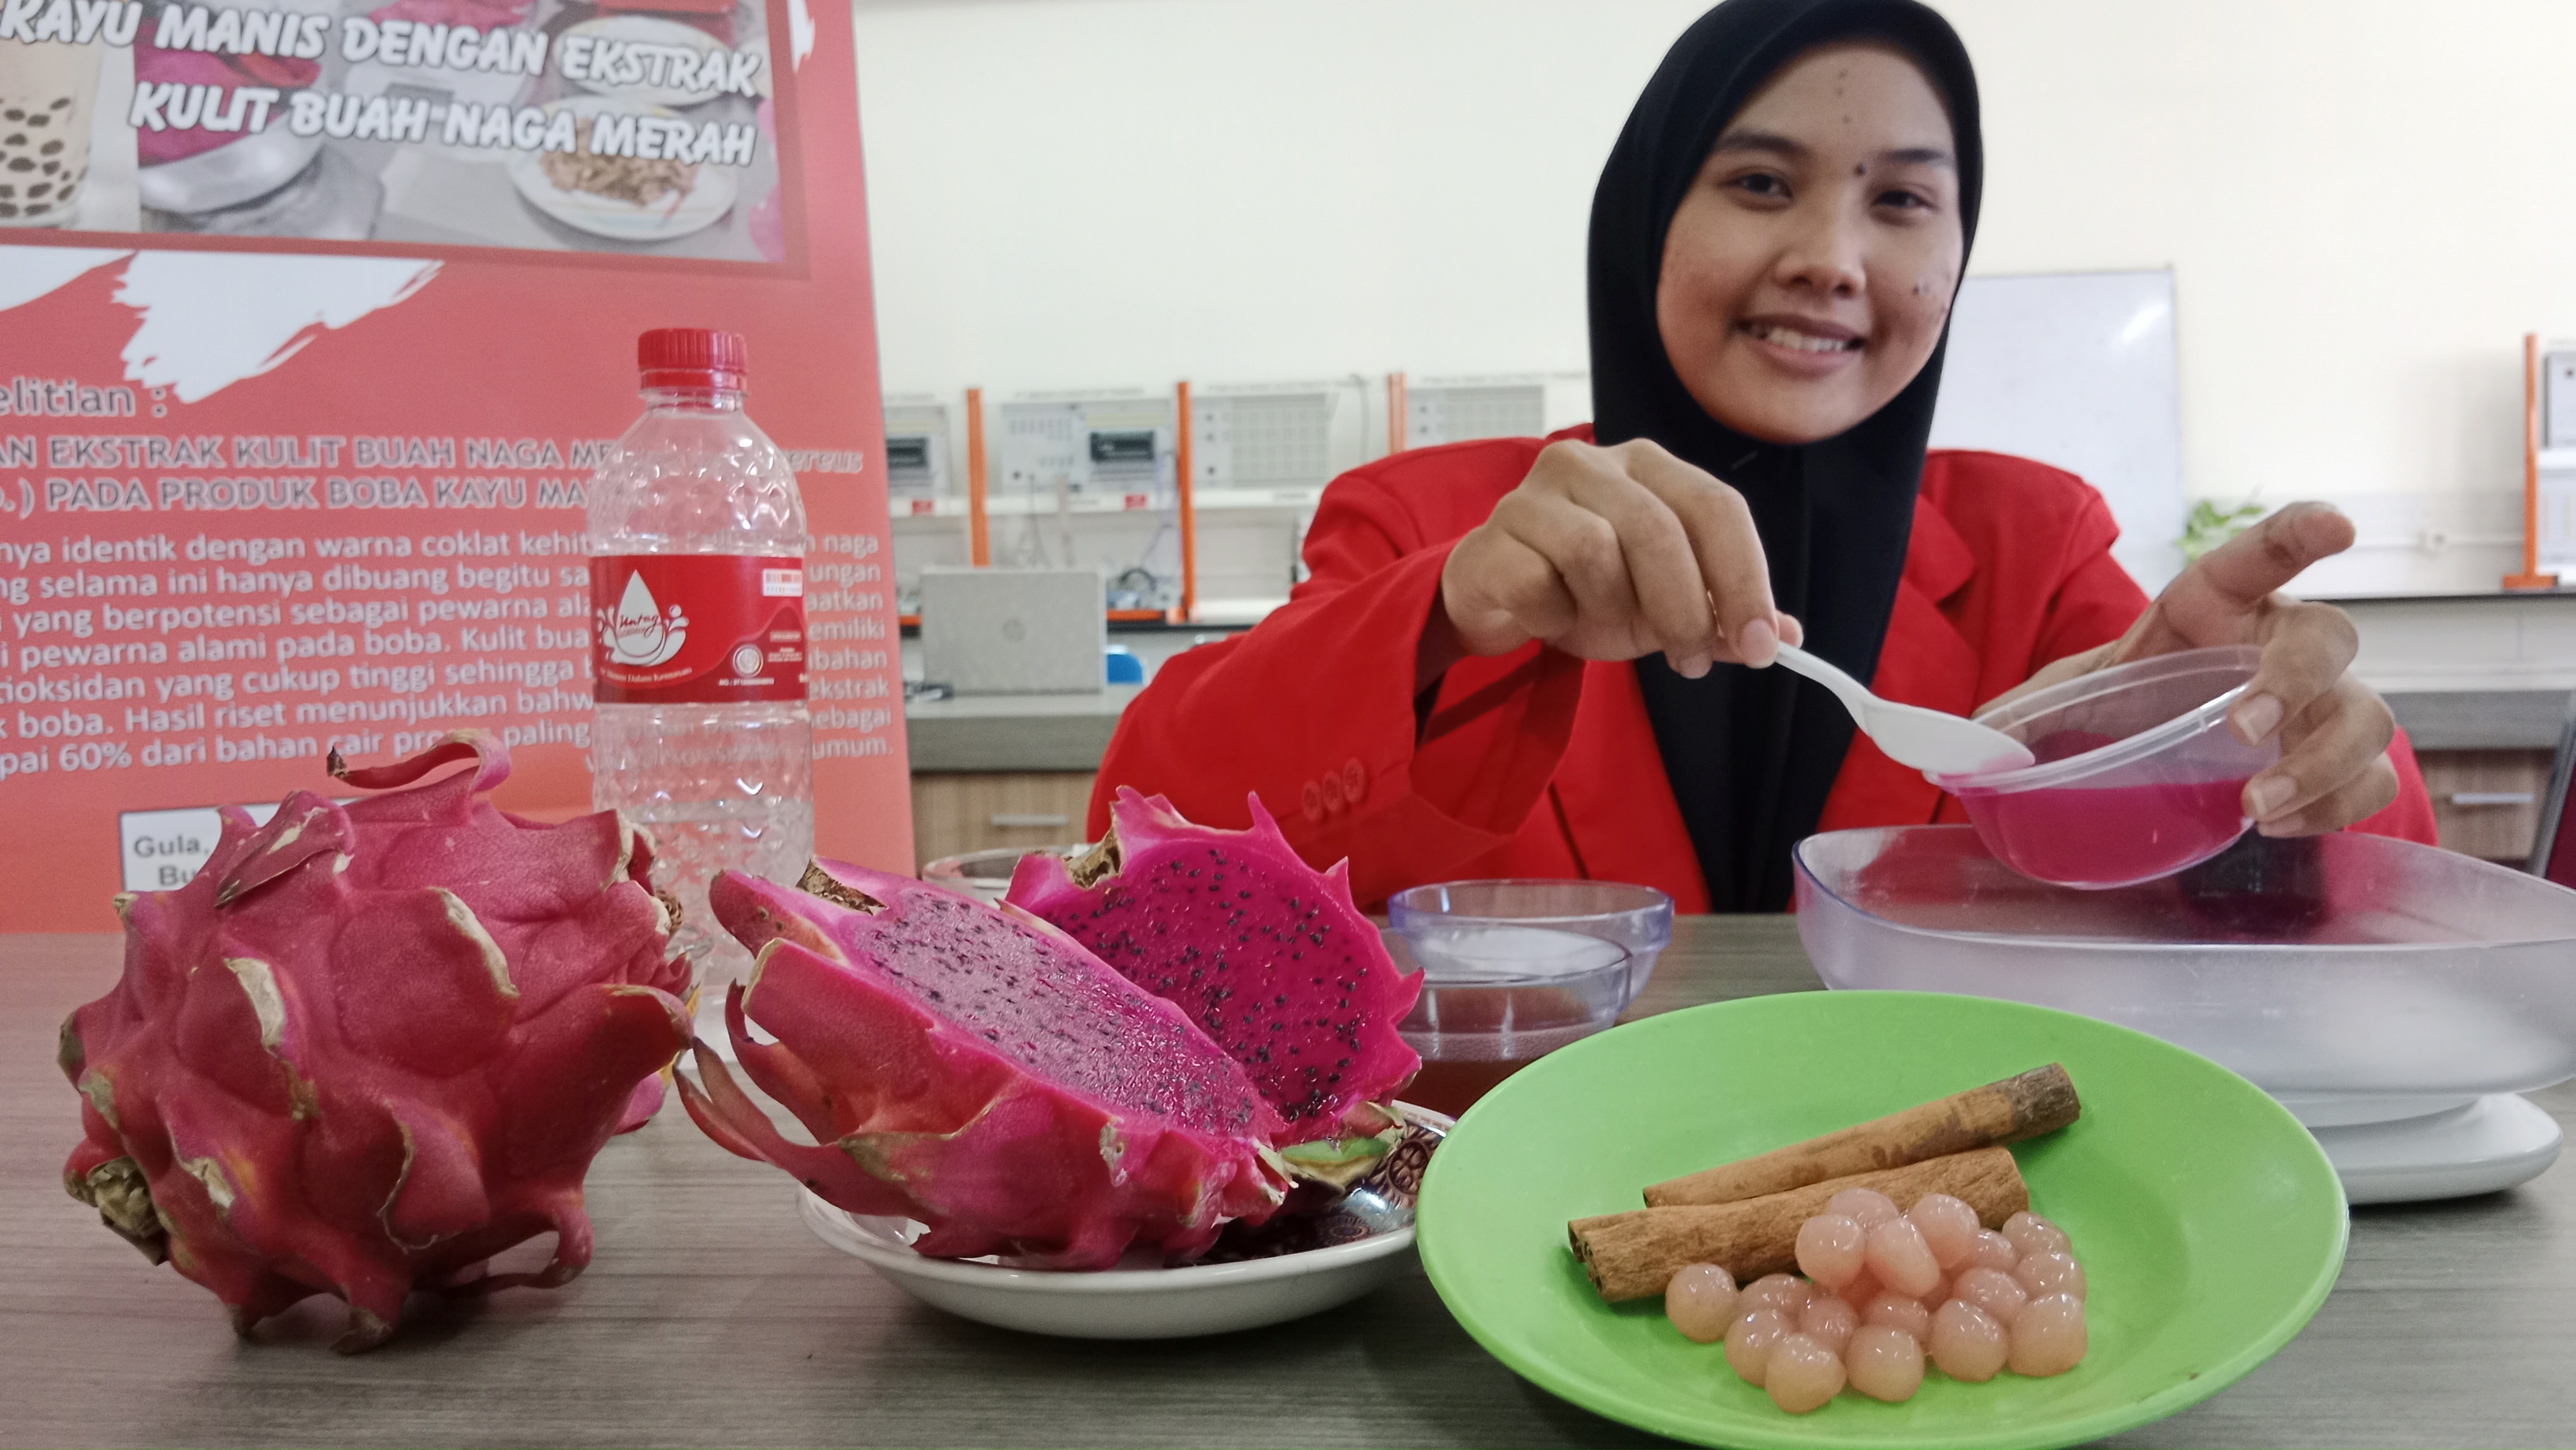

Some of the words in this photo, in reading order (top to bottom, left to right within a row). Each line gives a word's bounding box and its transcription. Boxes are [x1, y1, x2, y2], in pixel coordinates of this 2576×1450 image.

[0, 0, 143, 46] KAYU
[155, 4, 330, 58] MANIS
[342, 16, 549, 77] DENGAN
[562, 36, 764, 97] EKSTRAK
[128, 81, 280, 133] KULIT
[289, 92, 431, 143] BUAH
[442, 102, 576, 155] NAGA
[590, 113, 756, 166] MERAH
[47, 435, 226, 468] EKSTRAK
[233, 434, 346, 468] KULIT
[354, 436, 456, 469] BUAH
[465, 438, 564, 469] NAGA
[45, 476, 152, 511] PADA
[158, 477, 319, 511] PRODUK
[327, 476, 429, 509] BOBA
[433, 478, 527, 509] KAYU
[536, 477, 592, 509] MA
[62, 534, 177, 563] identik
[186, 534, 306, 565] dengan
[315, 536, 412, 558] warna
[421, 530, 510, 556] coklat
[823, 534, 879, 559] naga
[39, 568, 158, 599] selama
[169, 568, 208, 594] ini
[216, 566, 313, 597] hanya
[323, 564, 448, 595] dibuang
[456, 563, 551, 593] begitu
[13, 609, 93, 638] yang
[103, 600, 282, 635] berpotensi
[290, 596, 408, 628] sebagai
[419, 597, 549, 626] pewarna
[21, 640, 167, 674] pewarna
[178, 633, 266, 662] alami
[276, 628, 355, 664] pada
[364, 627, 451, 655] boba.
[461, 625, 527, 652] Kulit
[155, 672, 234, 703] yang
[242, 664, 341, 695] cukup
[349, 660, 435, 692] tinggi
[444, 655, 575, 687] sehingga
[18, 708, 114, 739] boba.
[125, 701, 206, 733] Hasil
[214, 700, 287, 728] riset
[295, 692, 508, 726] menunjukkan
[59, 740, 133, 772] 60%
[141, 737, 206, 767] dari
[216, 733, 318, 763] bahan
[326, 728, 384, 756] cair
[503, 718, 592, 749] paling
